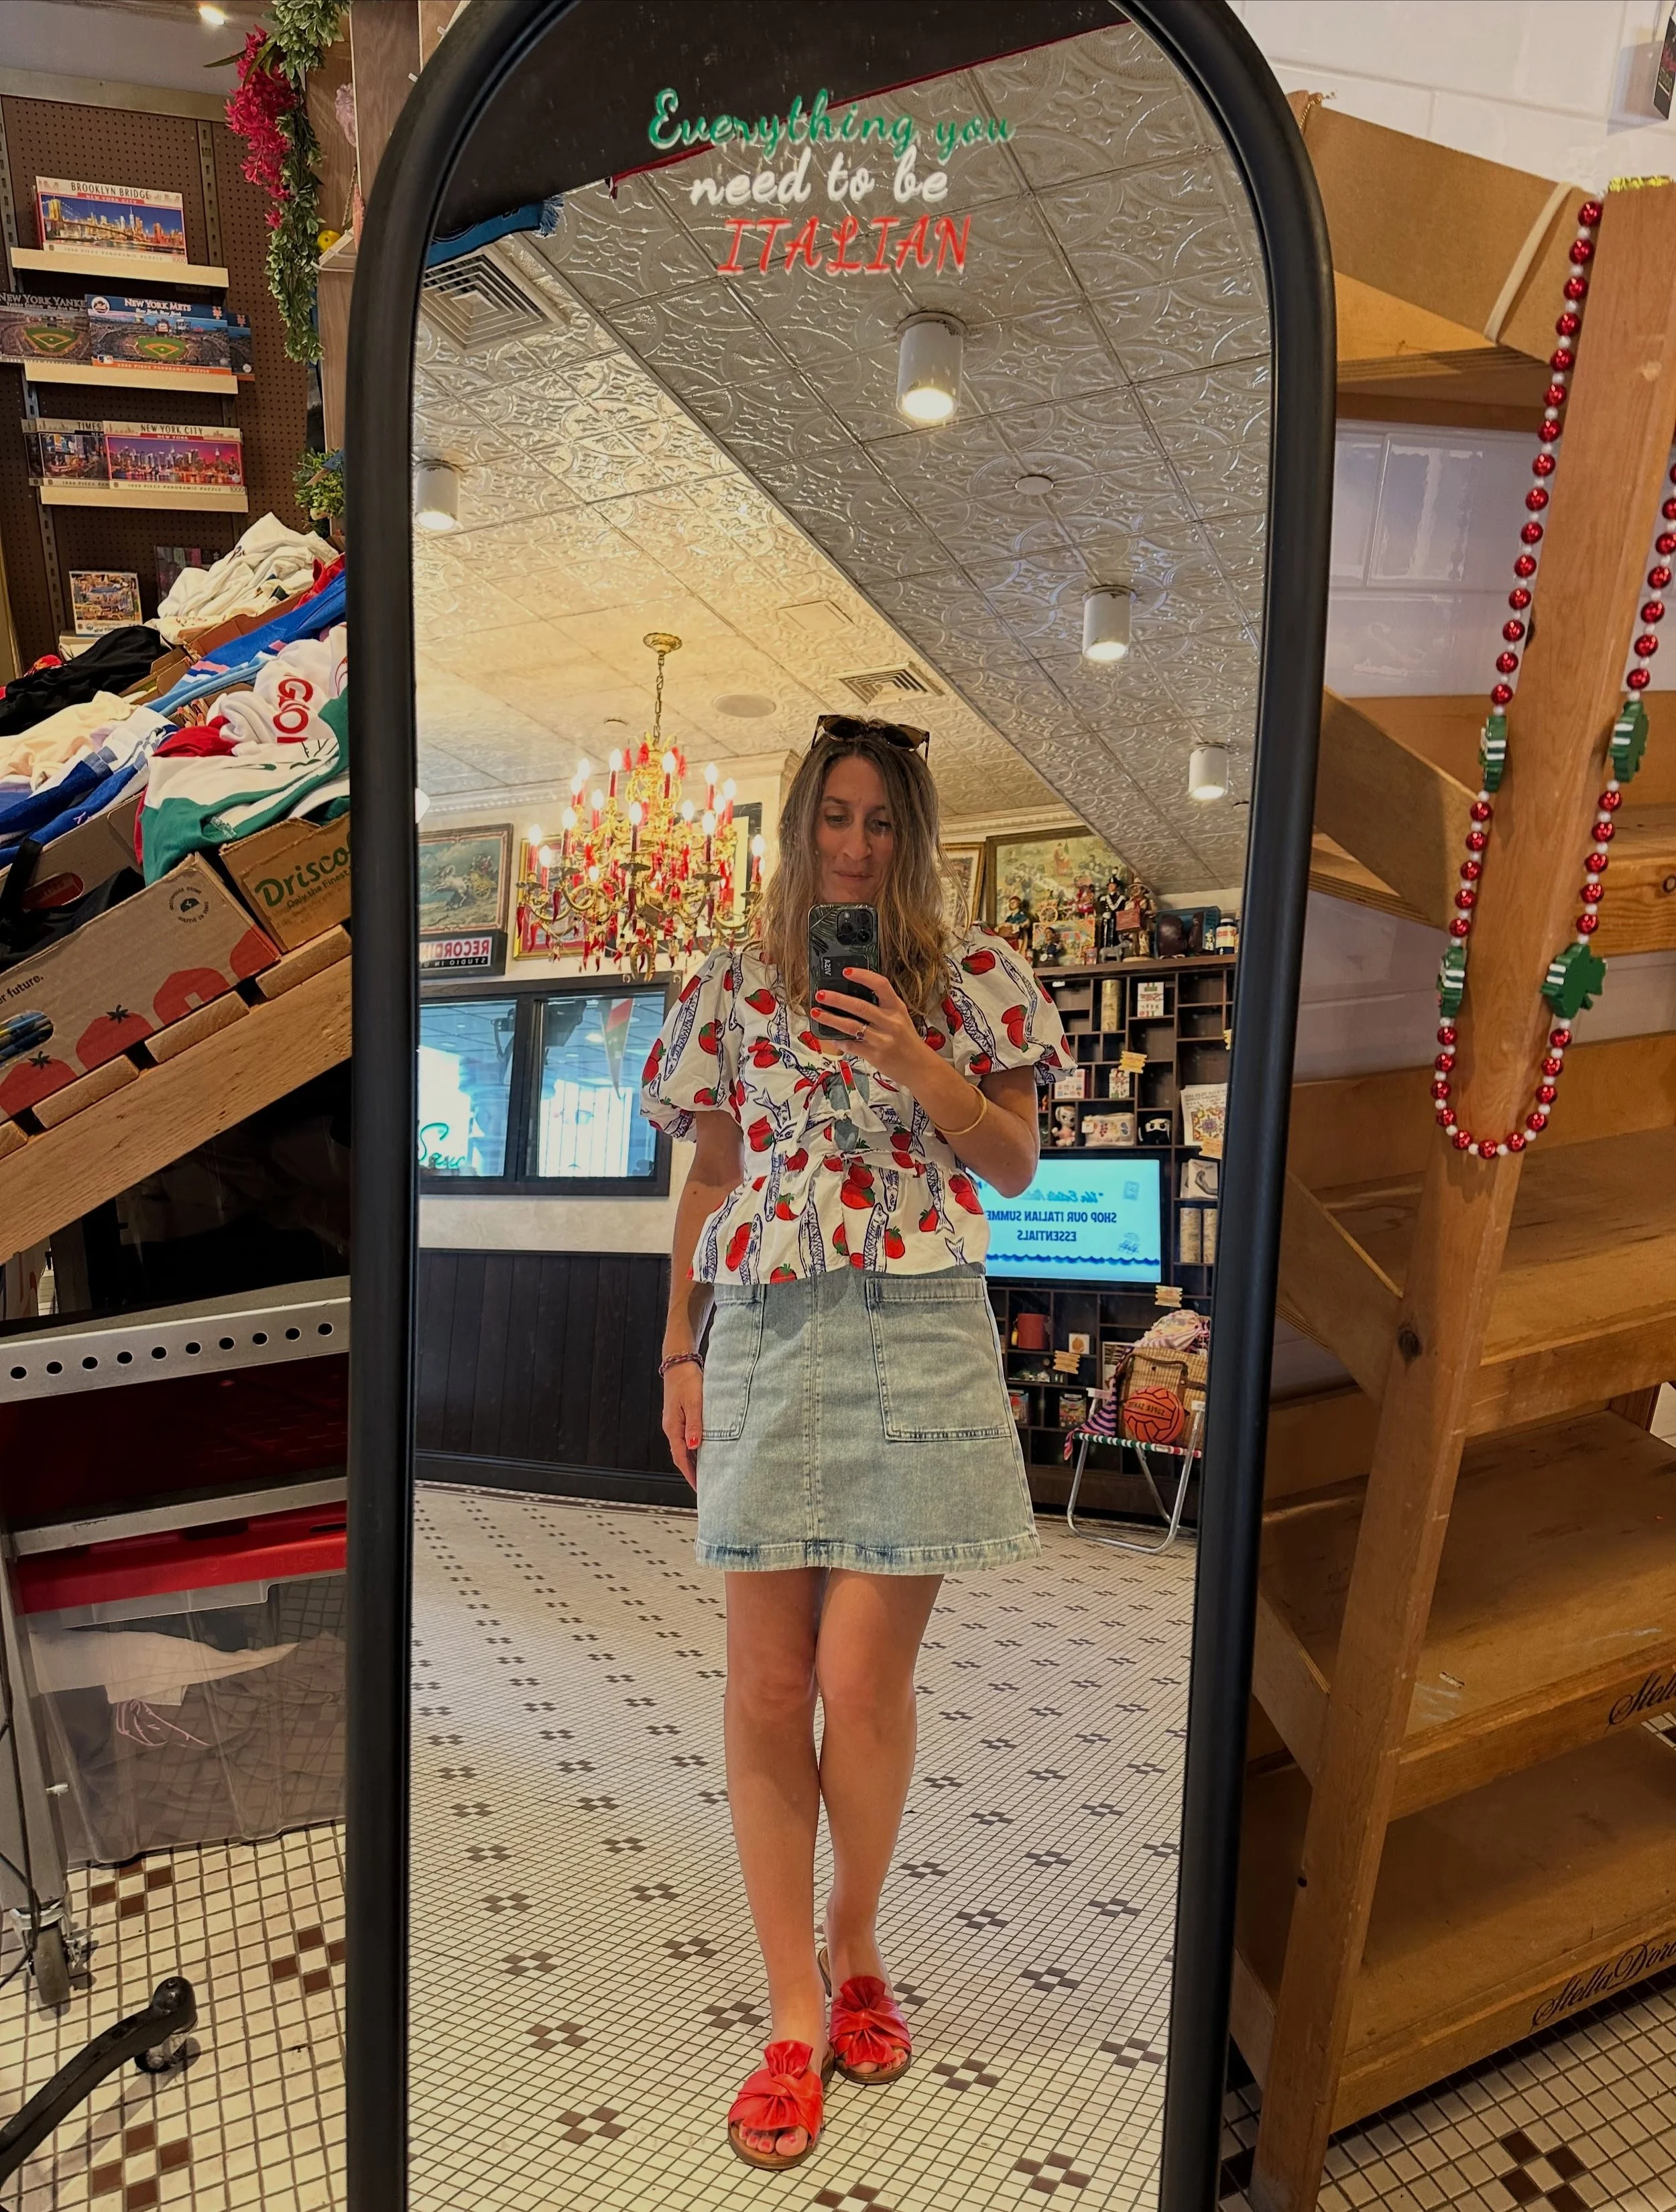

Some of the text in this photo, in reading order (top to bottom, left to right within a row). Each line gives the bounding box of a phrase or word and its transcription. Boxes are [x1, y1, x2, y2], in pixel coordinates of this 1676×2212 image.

[648, 88, 1016, 166] Everything you
[689, 145, 948, 205] need to be
[71, 182, 149, 200] BROOKLYN BRIDGE
[717, 214, 971, 275] ITALIAN
[0, 292, 21, 303] NEW
[23, 294, 52, 306] YORK
[124, 298, 192, 312] NEW YORK METS
[77, 421, 101, 431] TIMES
[140, 424, 203, 436] NEW YORK CITY
[7, 975, 44, 998] future.
[1529, 1963, 1614, 2035] Stella
